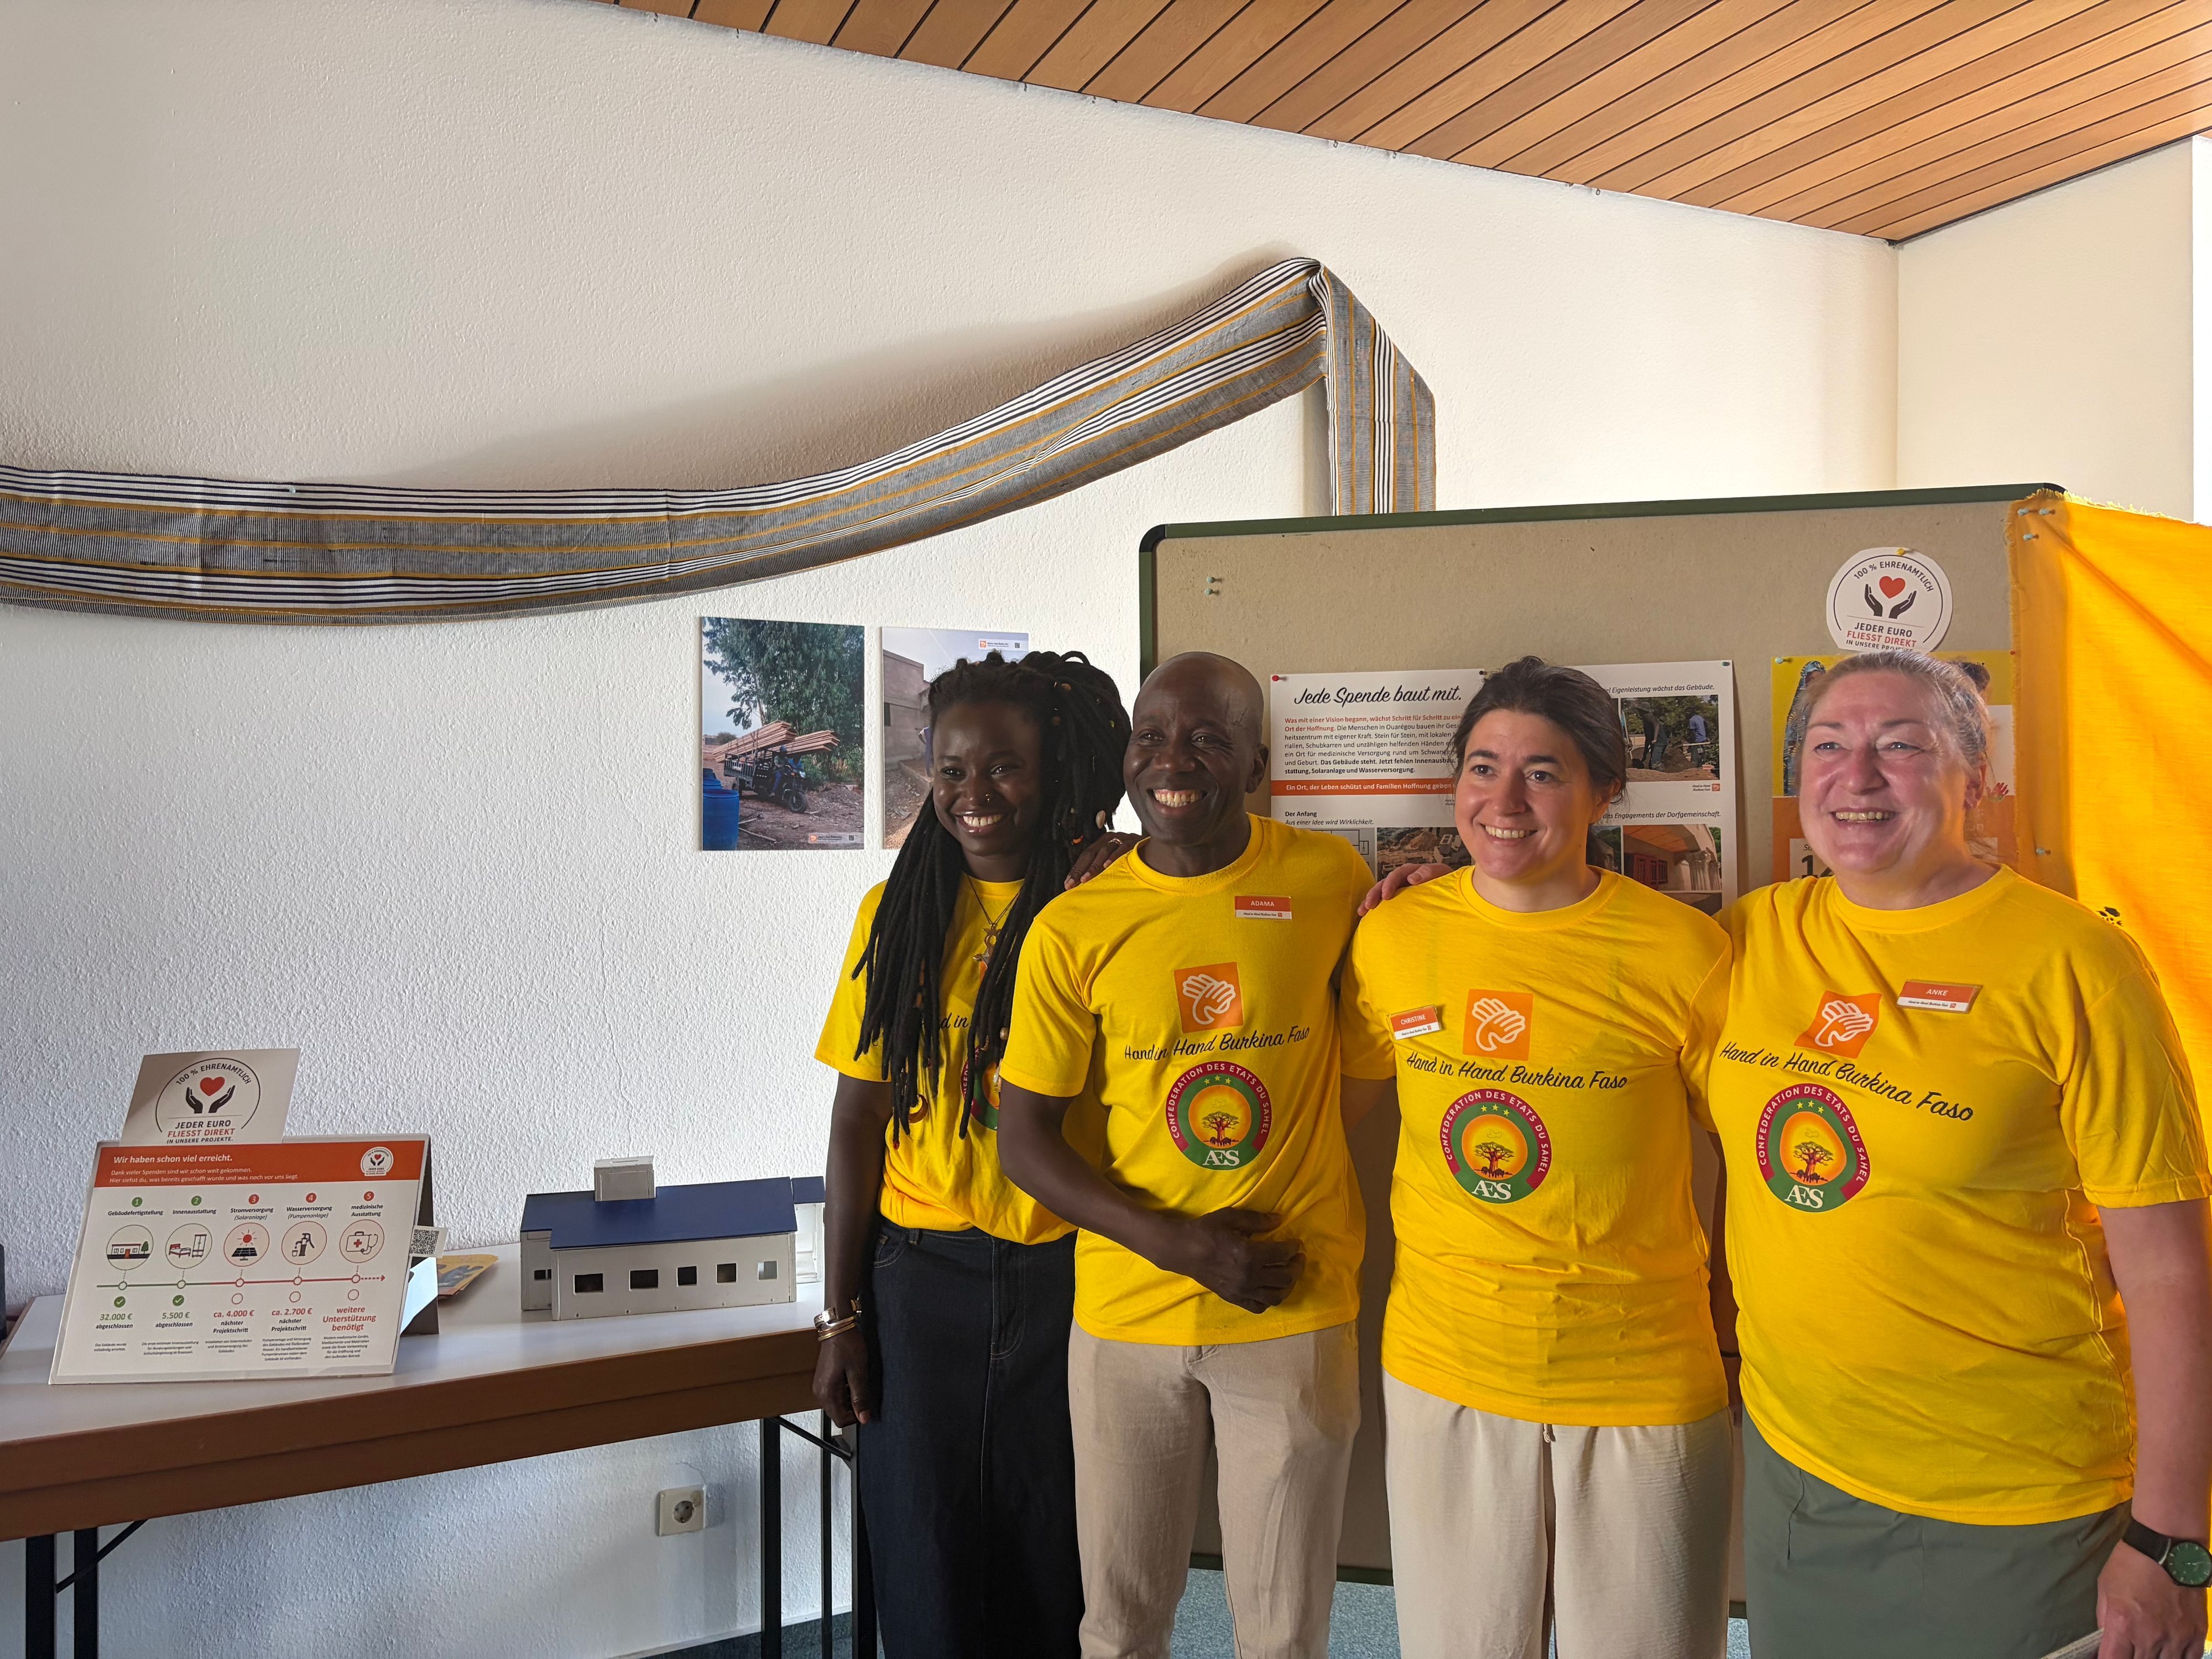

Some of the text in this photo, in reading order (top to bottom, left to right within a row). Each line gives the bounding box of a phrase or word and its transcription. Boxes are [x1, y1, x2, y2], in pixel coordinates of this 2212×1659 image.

[1854, 567, 1868, 580] 100
[1880, 561, 1934, 592] EHRENAMTLICH
[1847, 630, 1917, 648] FLIESST DIREKT
[1854, 622, 1912, 637] JEDER EURO
[1855, 640, 1880, 649] UNSERE
[1294, 685, 1462, 708] Jede Spende baut mit.
[953, 1015, 969, 1028] in
[1400, 1014, 1426, 1025] CHRISTINE
[1125, 1025, 1310, 1061] Hand in Hand Burkina Faso
[176, 1073, 190, 1085] 100
[201, 1063, 252, 1084] EHRENAMTLICH
[1407, 1051, 1628, 1089] Hand in Hand Burkina Faso
[1719, 1041, 1974, 1121] Hand in Hand Burkina Faso
[1168, 1066, 1203, 1139] CONFEDERATION
[1229, 1065, 1256, 1085] ETATS
[1256, 1086, 1266, 1099] DU
[1261, 1102, 1269, 1134] SAHEL
[168, 1129, 202, 1138] FLIESST
[1442, 1091, 1548, 1172] CONFEDERATION DES ETATS DU SAHEL
[1759, 1086, 1868, 1182] CONFEDERATION DES ETATS DU SAHEL
[182, 1154, 197, 1162] viel
[199, 1154, 232, 1162] erreicht.
[322, 1314, 376, 1323] Unterstützung
[331, 1323, 364, 1332] benötigt
